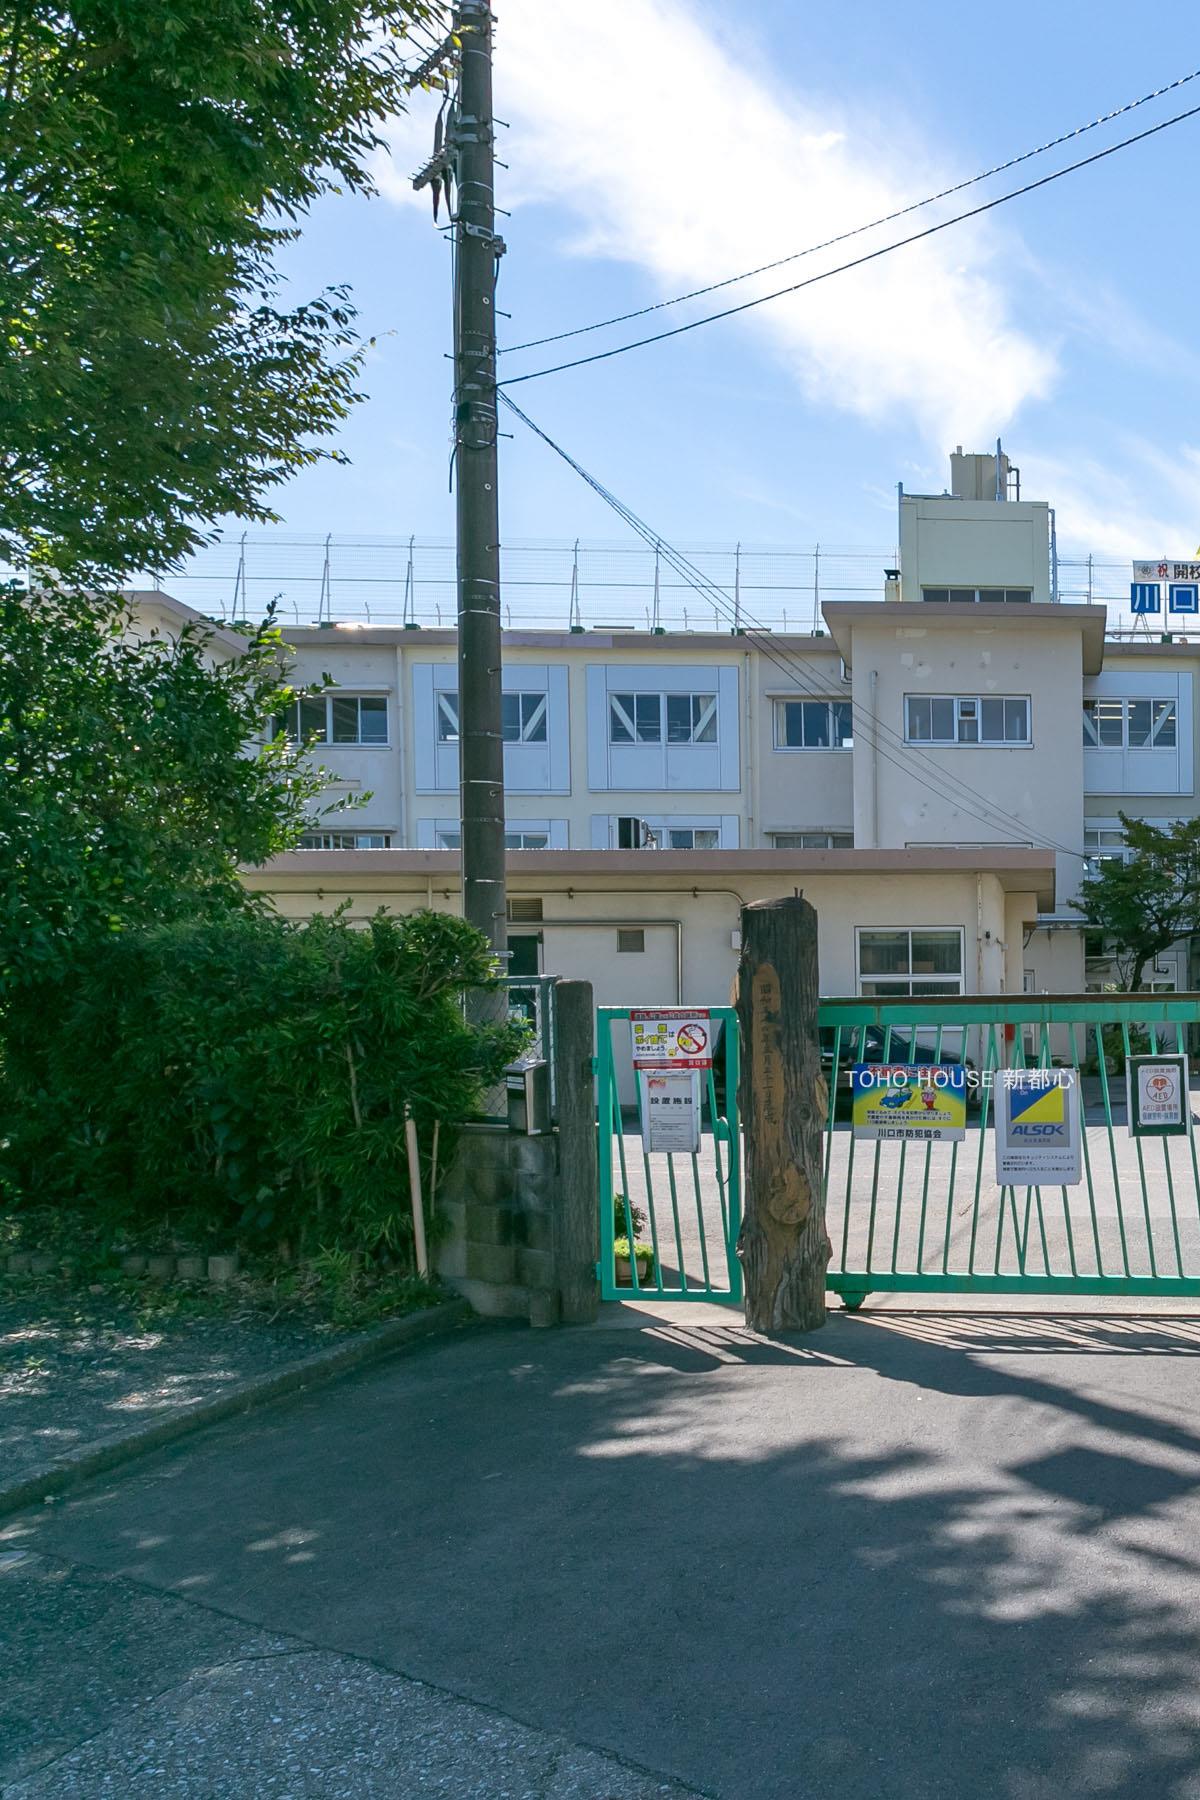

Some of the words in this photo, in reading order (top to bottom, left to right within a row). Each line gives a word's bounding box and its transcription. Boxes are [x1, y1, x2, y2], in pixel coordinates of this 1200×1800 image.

[1157, 563, 1169, 578] 祝
[877, 1128, 942, 1139] 川口市防犯協会
[1011, 1125, 1065, 1136] ALSOK
